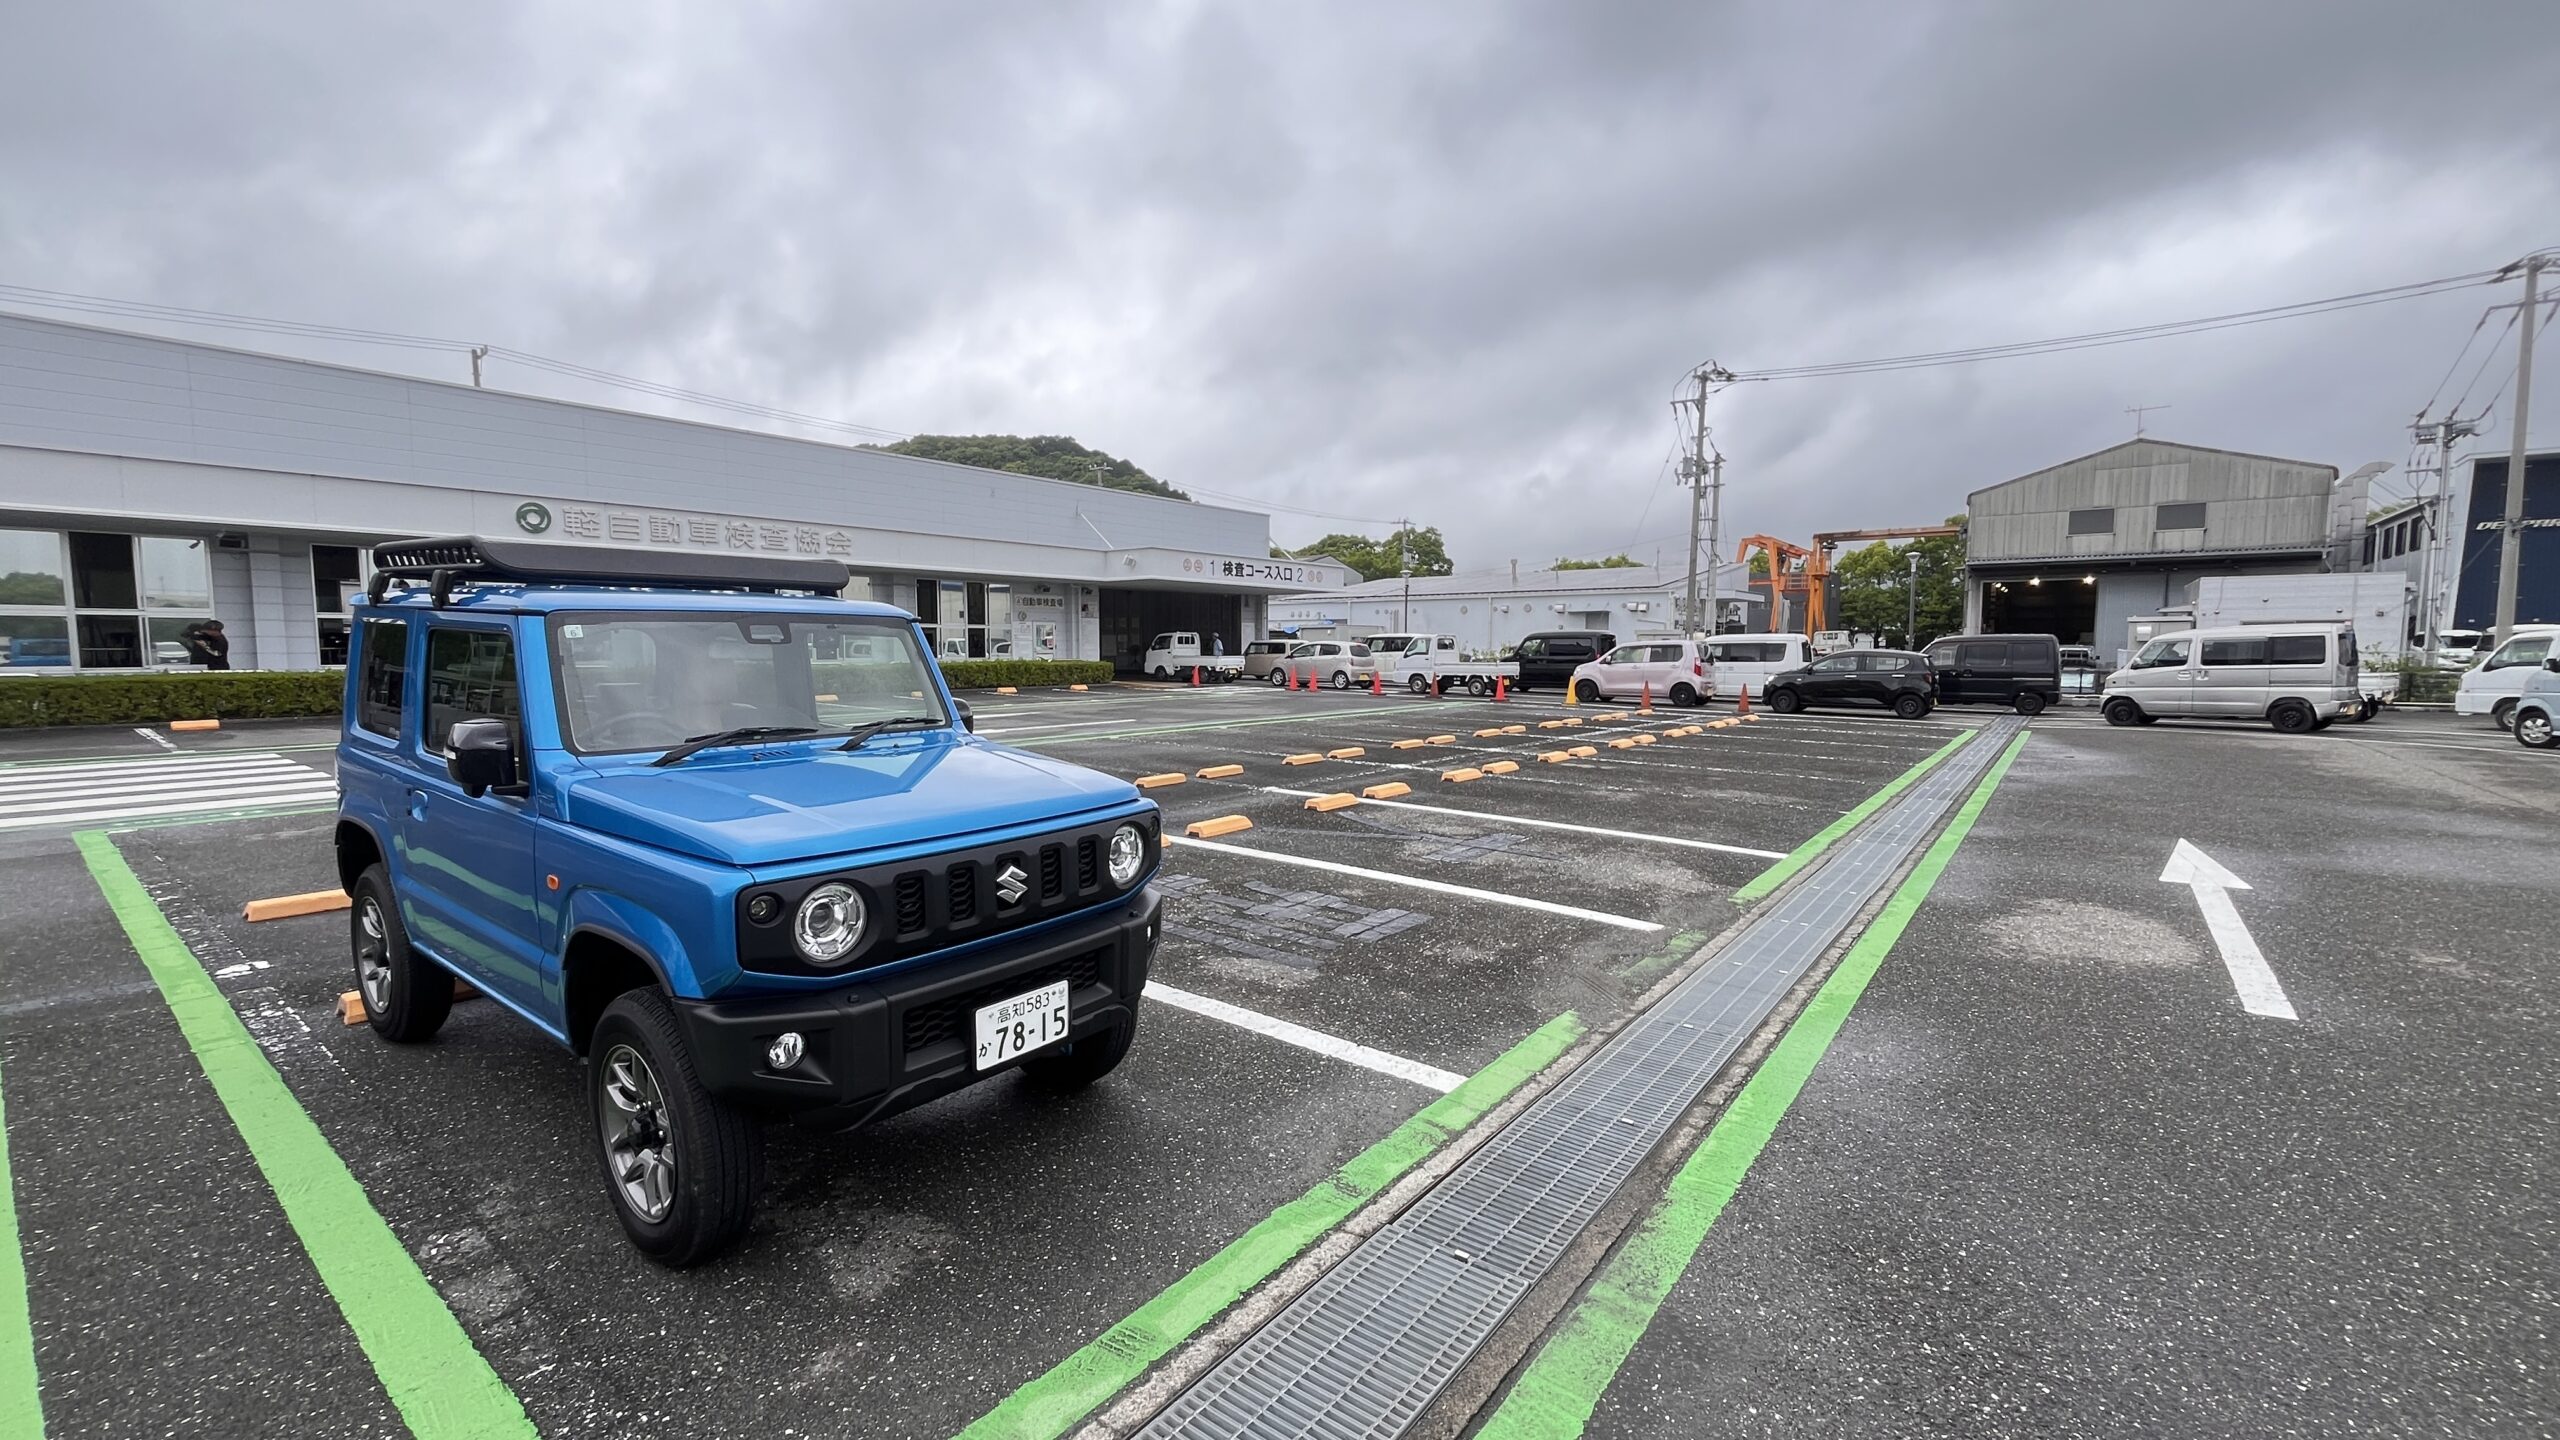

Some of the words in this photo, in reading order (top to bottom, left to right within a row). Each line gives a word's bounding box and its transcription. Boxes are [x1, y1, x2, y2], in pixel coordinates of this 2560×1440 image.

[562, 506, 852, 556] 軽自動車検査協会
[1209, 559, 1215, 576] 1
[1223, 561, 1293, 582] 検査コース入口
[1296, 568, 1304, 583] 2
[996, 1005, 1066, 1059] 78-15
